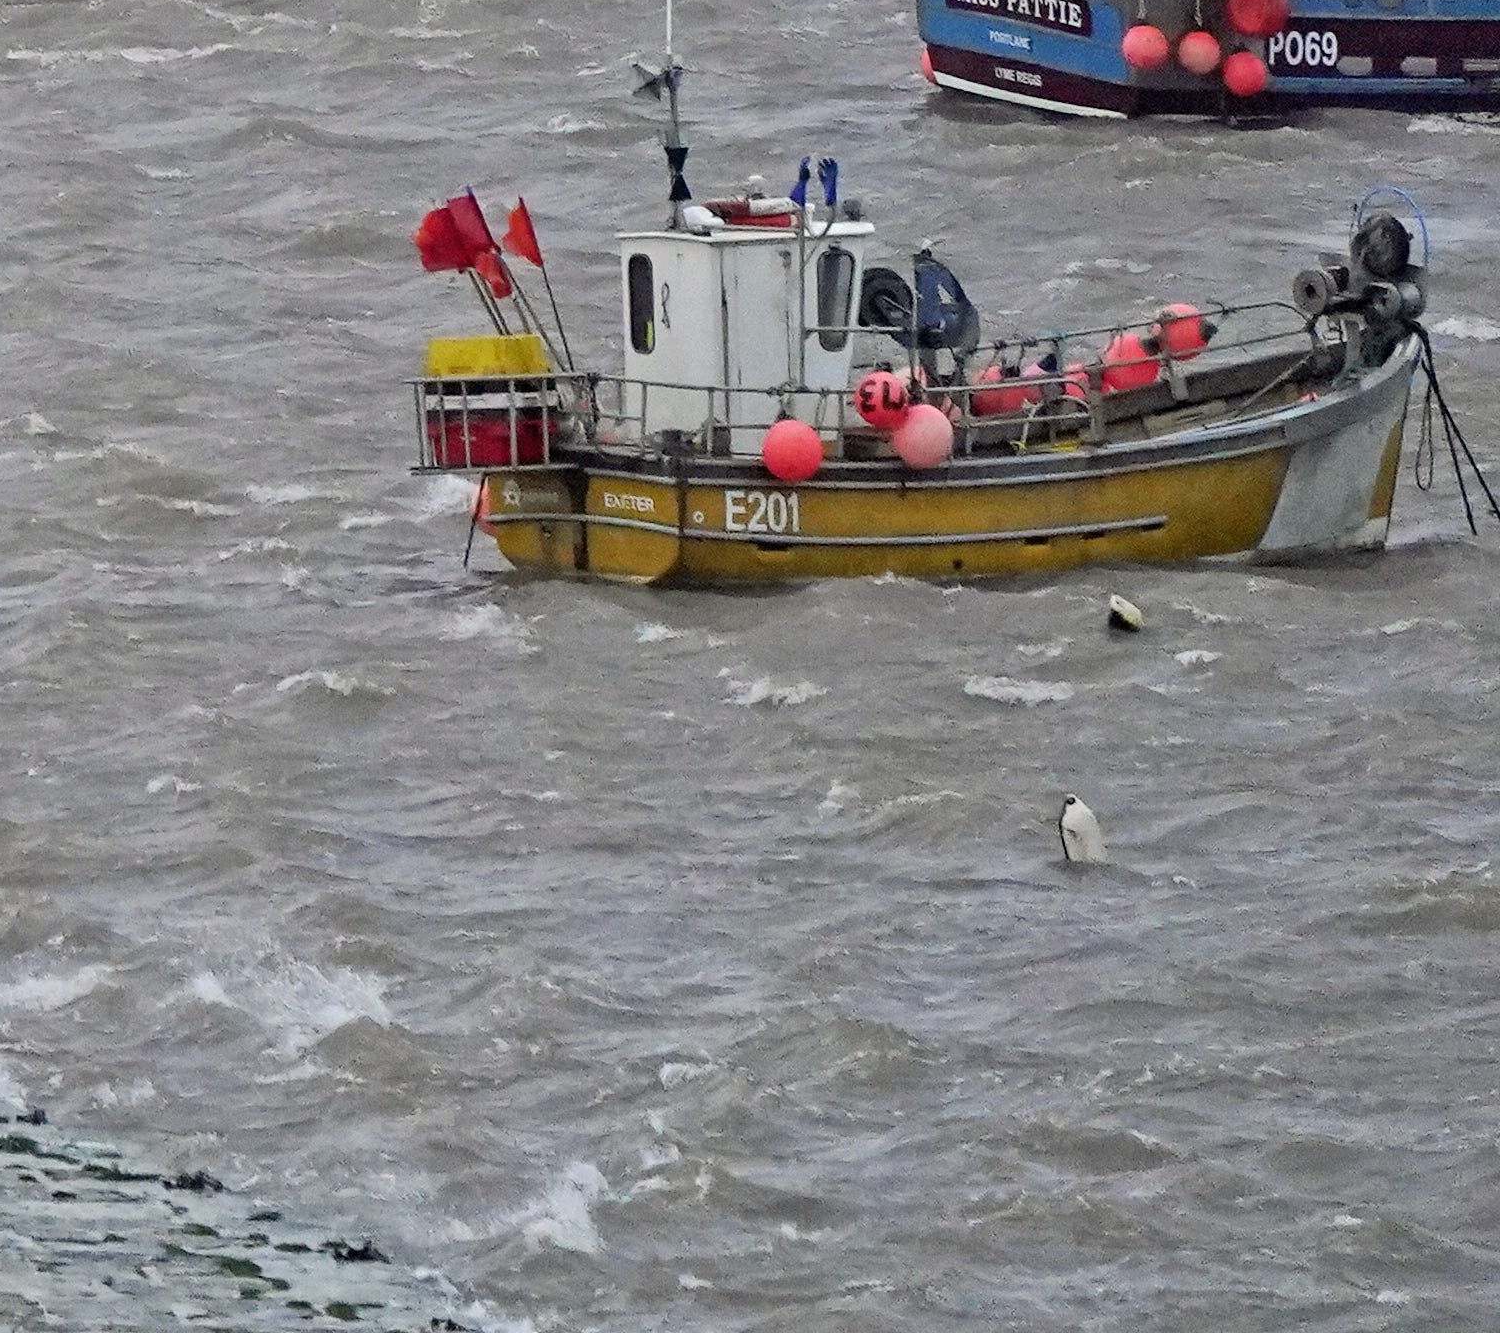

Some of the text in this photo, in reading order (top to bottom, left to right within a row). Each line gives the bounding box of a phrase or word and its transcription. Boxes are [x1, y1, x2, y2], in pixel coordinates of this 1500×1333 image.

[1268, 30, 1338, 66] PO69
[994, 66, 1043, 87] LYME REGIS
[604, 491, 655, 513] EXETER
[724, 488, 800, 533] E201
